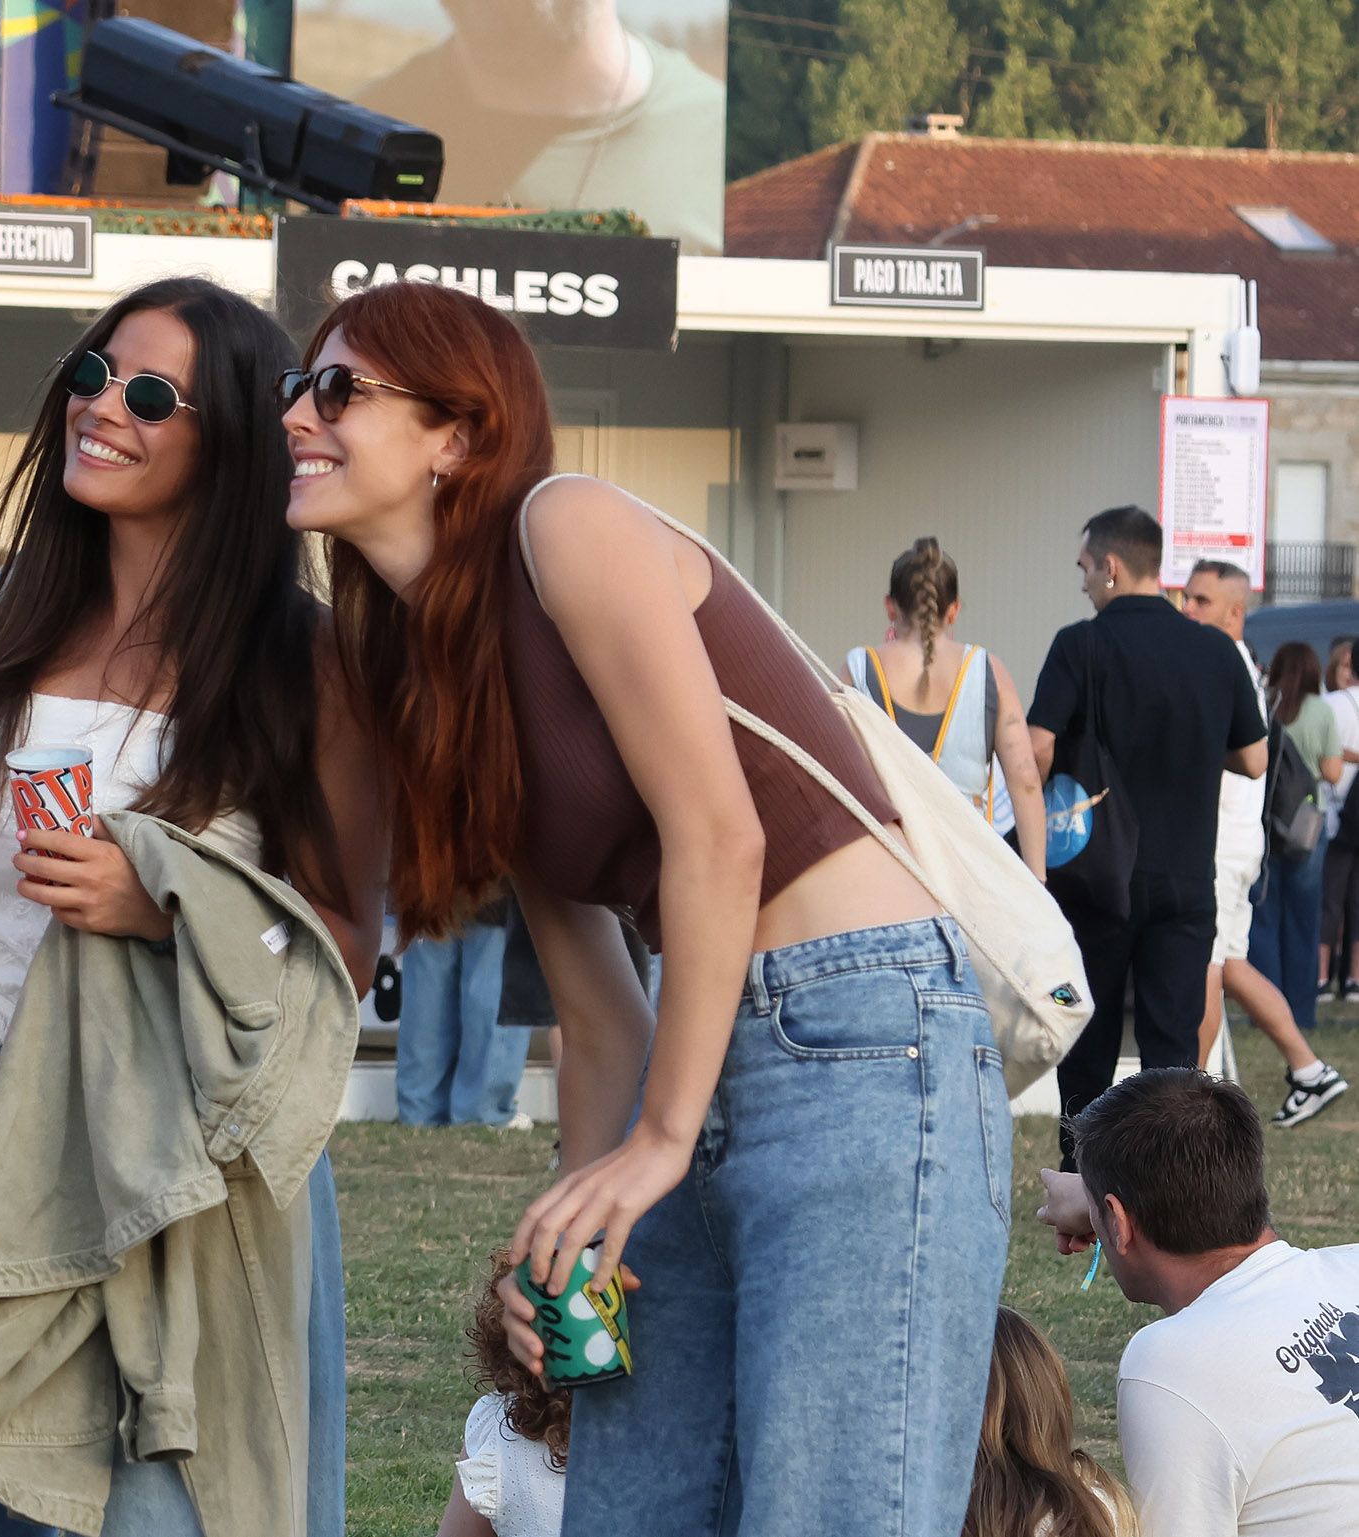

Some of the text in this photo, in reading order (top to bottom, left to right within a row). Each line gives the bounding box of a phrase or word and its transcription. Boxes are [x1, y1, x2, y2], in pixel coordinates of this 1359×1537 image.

[853, 258, 964, 296] PAGO TARJETA
[1275, 1301, 1345, 1374] Originals
